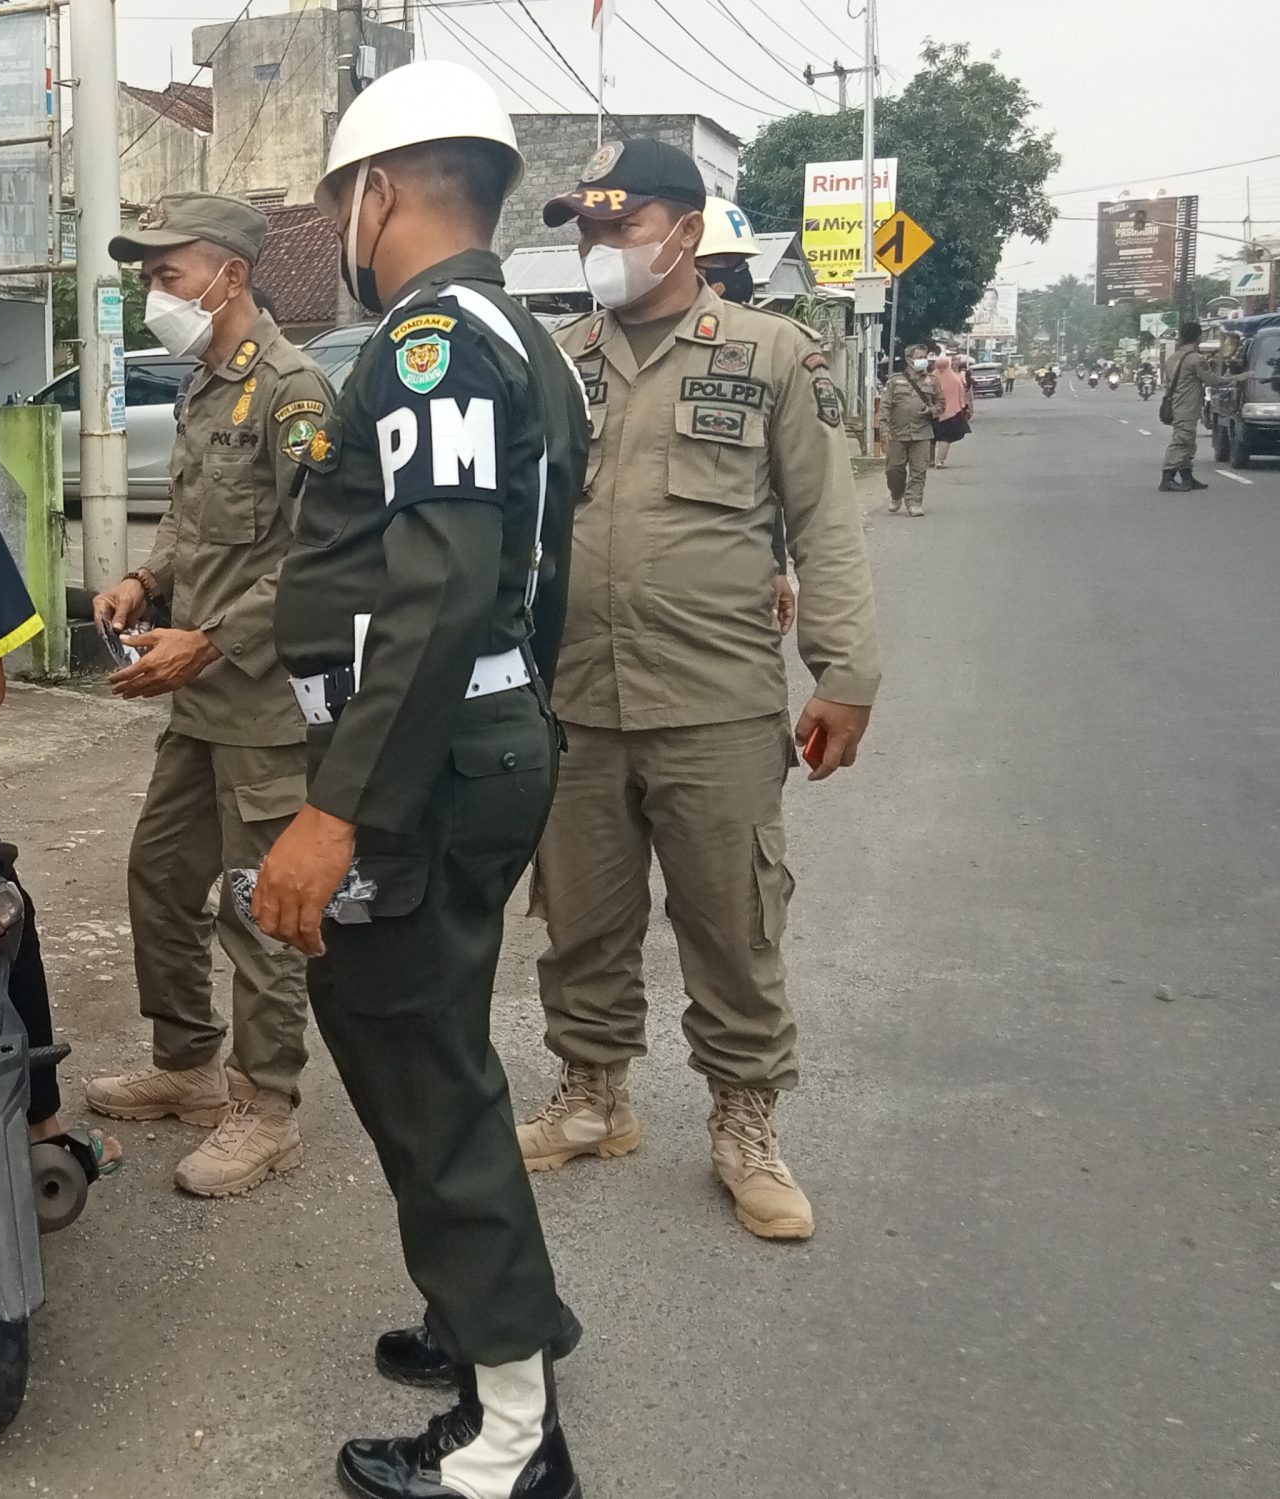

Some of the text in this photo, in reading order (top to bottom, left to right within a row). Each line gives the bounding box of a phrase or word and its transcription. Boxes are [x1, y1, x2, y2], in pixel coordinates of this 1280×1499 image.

[583, 189, 627, 211] PP
[807, 248, 862, 262] SHIMI
[393, 318, 441, 339] POMDAM
[689, 381, 757, 401] POL PP
[210, 431, 232, 446] POL
[376, 397, 497, 507] PM
